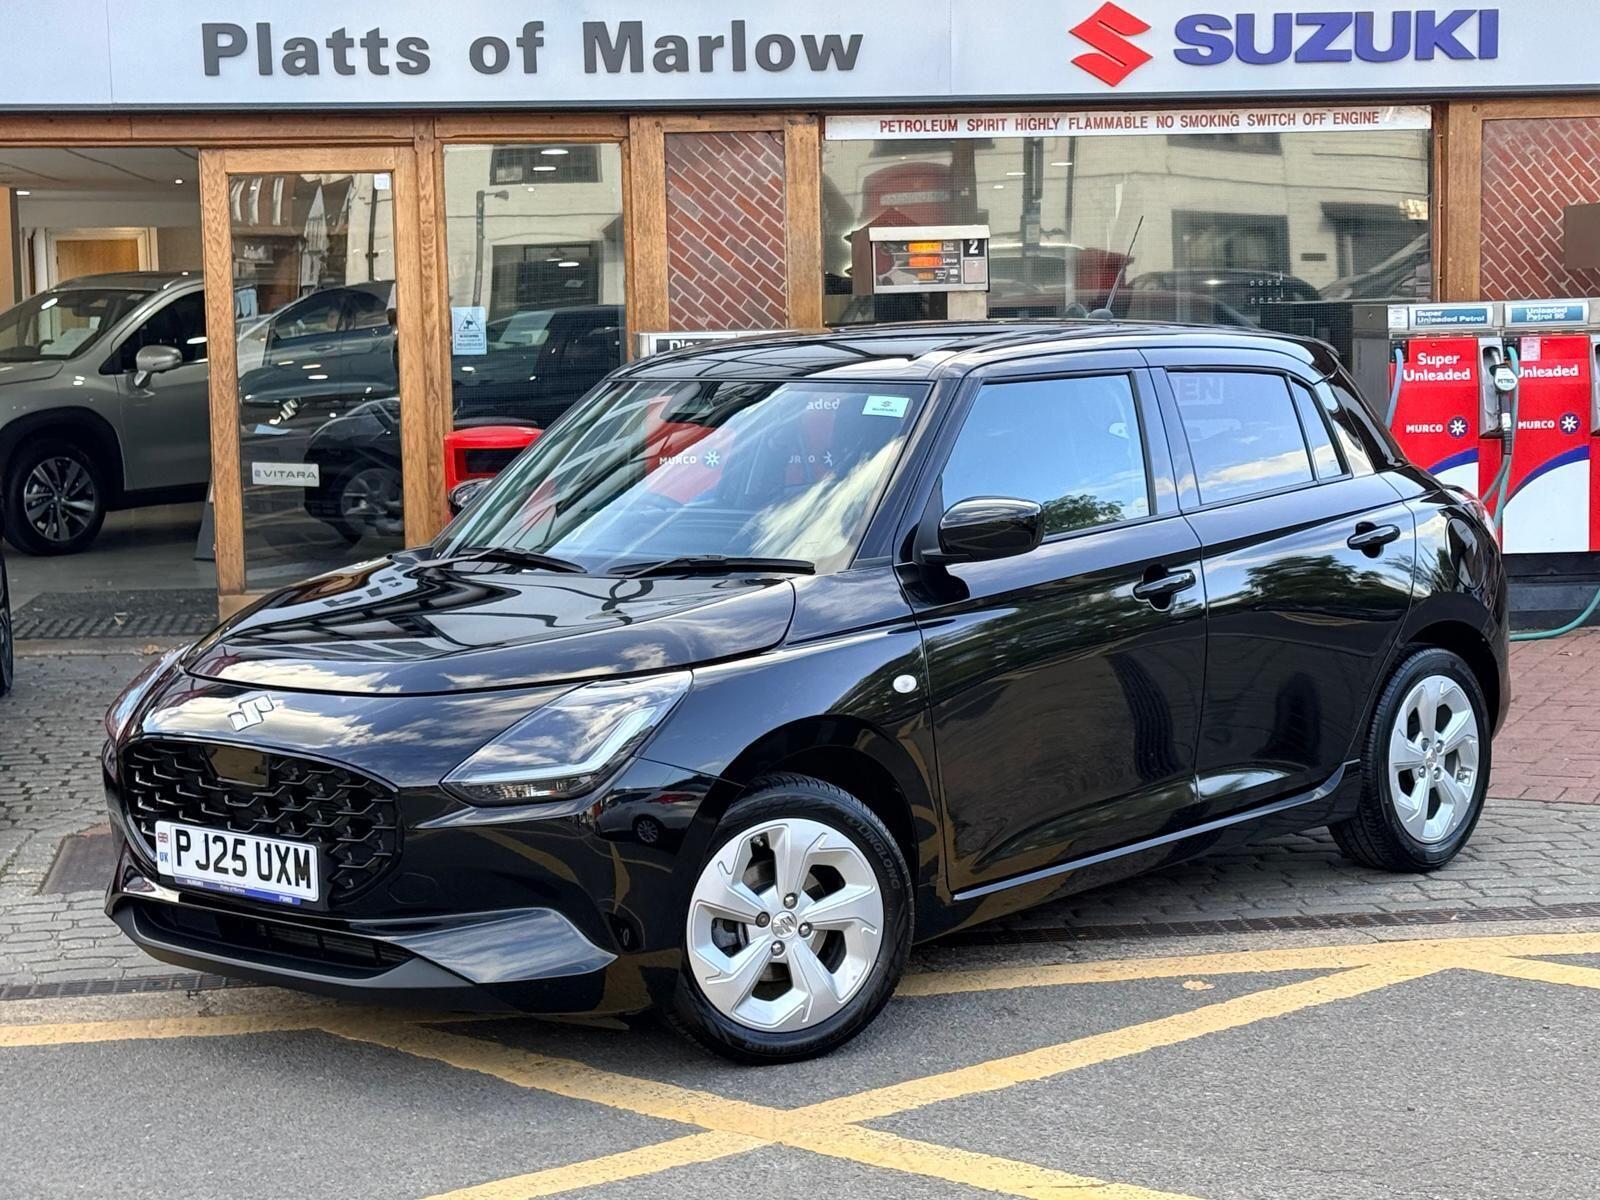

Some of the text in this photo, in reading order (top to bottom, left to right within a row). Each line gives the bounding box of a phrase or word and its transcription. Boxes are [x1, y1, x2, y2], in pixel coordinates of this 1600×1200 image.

[1173, 8, 1500, 66] SUZUKI
[201, 19, 864, 76] Platts of Marlow
[879, 111, 1380, 133] PETROLEUM SPIRIT HIGHLY FLAMMABLE NO SMOKING SWITCH OFF ENGINE
[968, 239, 979, 254] 2
[1417, 352, 1461, 369] Super
[1403, 368, 1471, 382] Unleaded
[1405, 424, 1444, 434] MURCO
[1518, 420, 1556, 431] MURCO
[263, 469, 317, 480] VITARA
[159, 851, 169, 863] UK
[175, 828, 312, 890] PJ25 UXM
